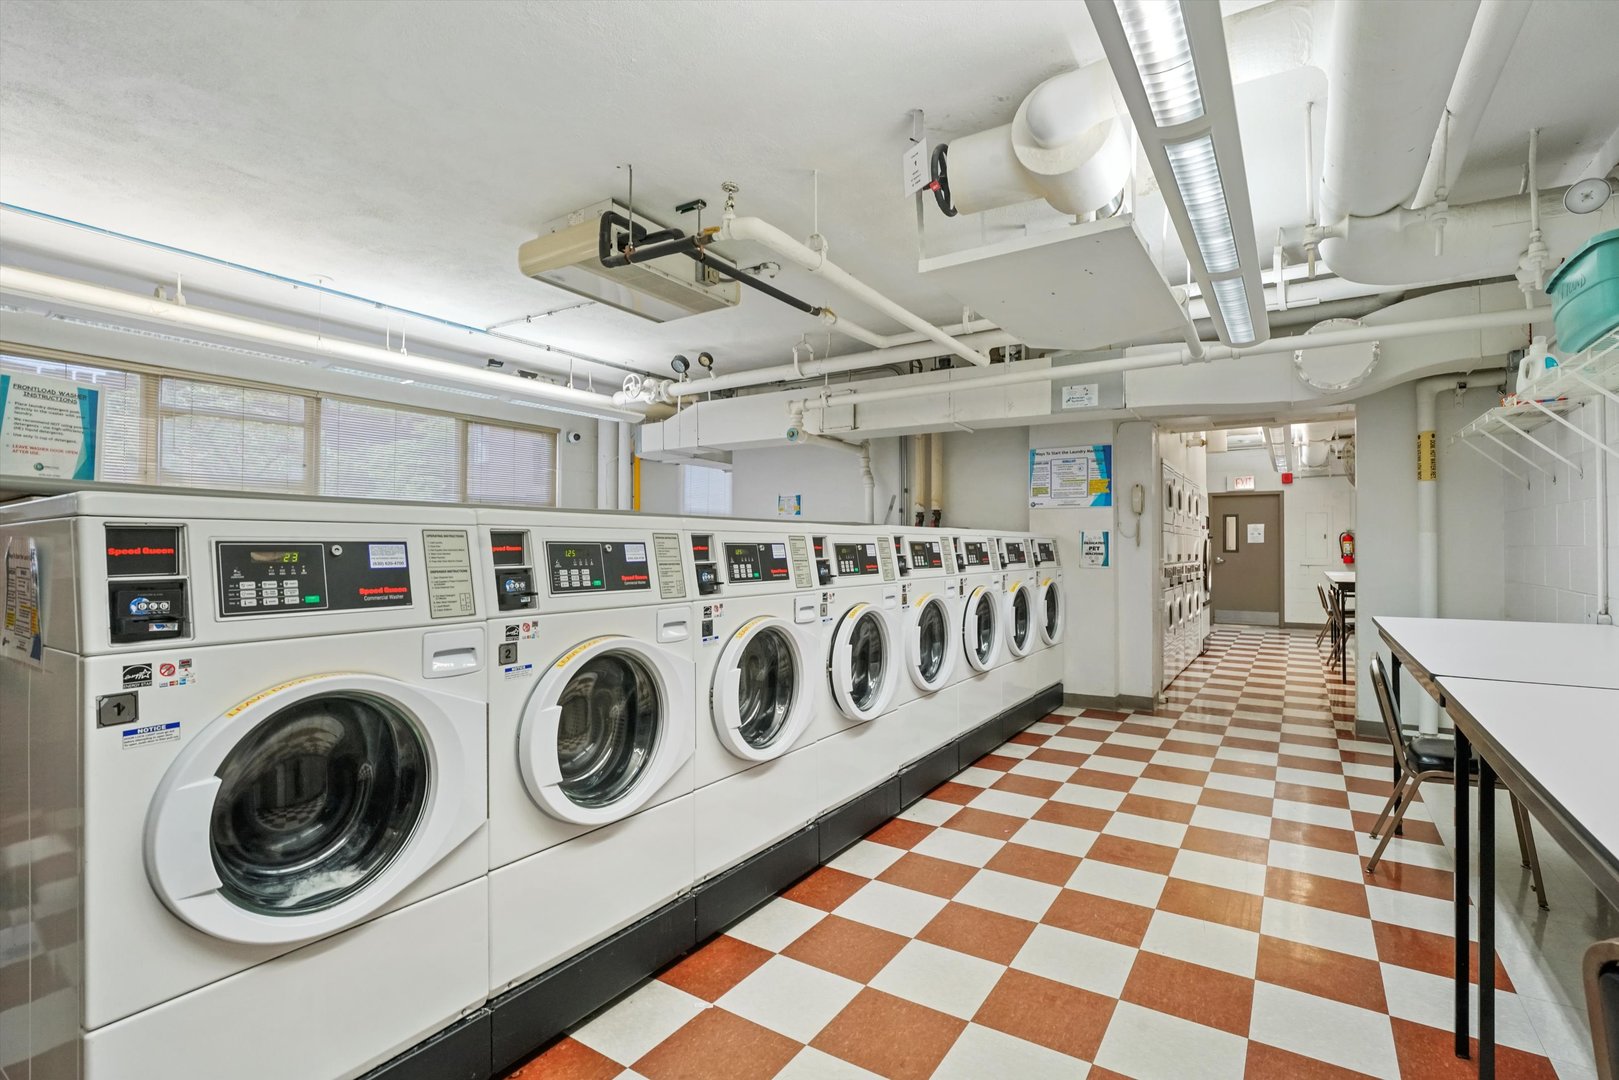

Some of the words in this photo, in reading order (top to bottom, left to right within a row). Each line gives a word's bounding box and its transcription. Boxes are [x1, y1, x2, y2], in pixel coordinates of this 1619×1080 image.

[13, 383, 56, 395] FRONTLOAD
[23, 392, 78, 404] INSTRUCTIONS
[1235, 477, 1252, 487] EXIT
[108, 547, 141, 556] Speed
[142, 547, 174, 555] Queen
[283, 553, 298, 562] 23
[359, 587, 383, 595] Speed
[505, 649, 511, 659] 2
[137, 725, 167, 734] NOTICE
